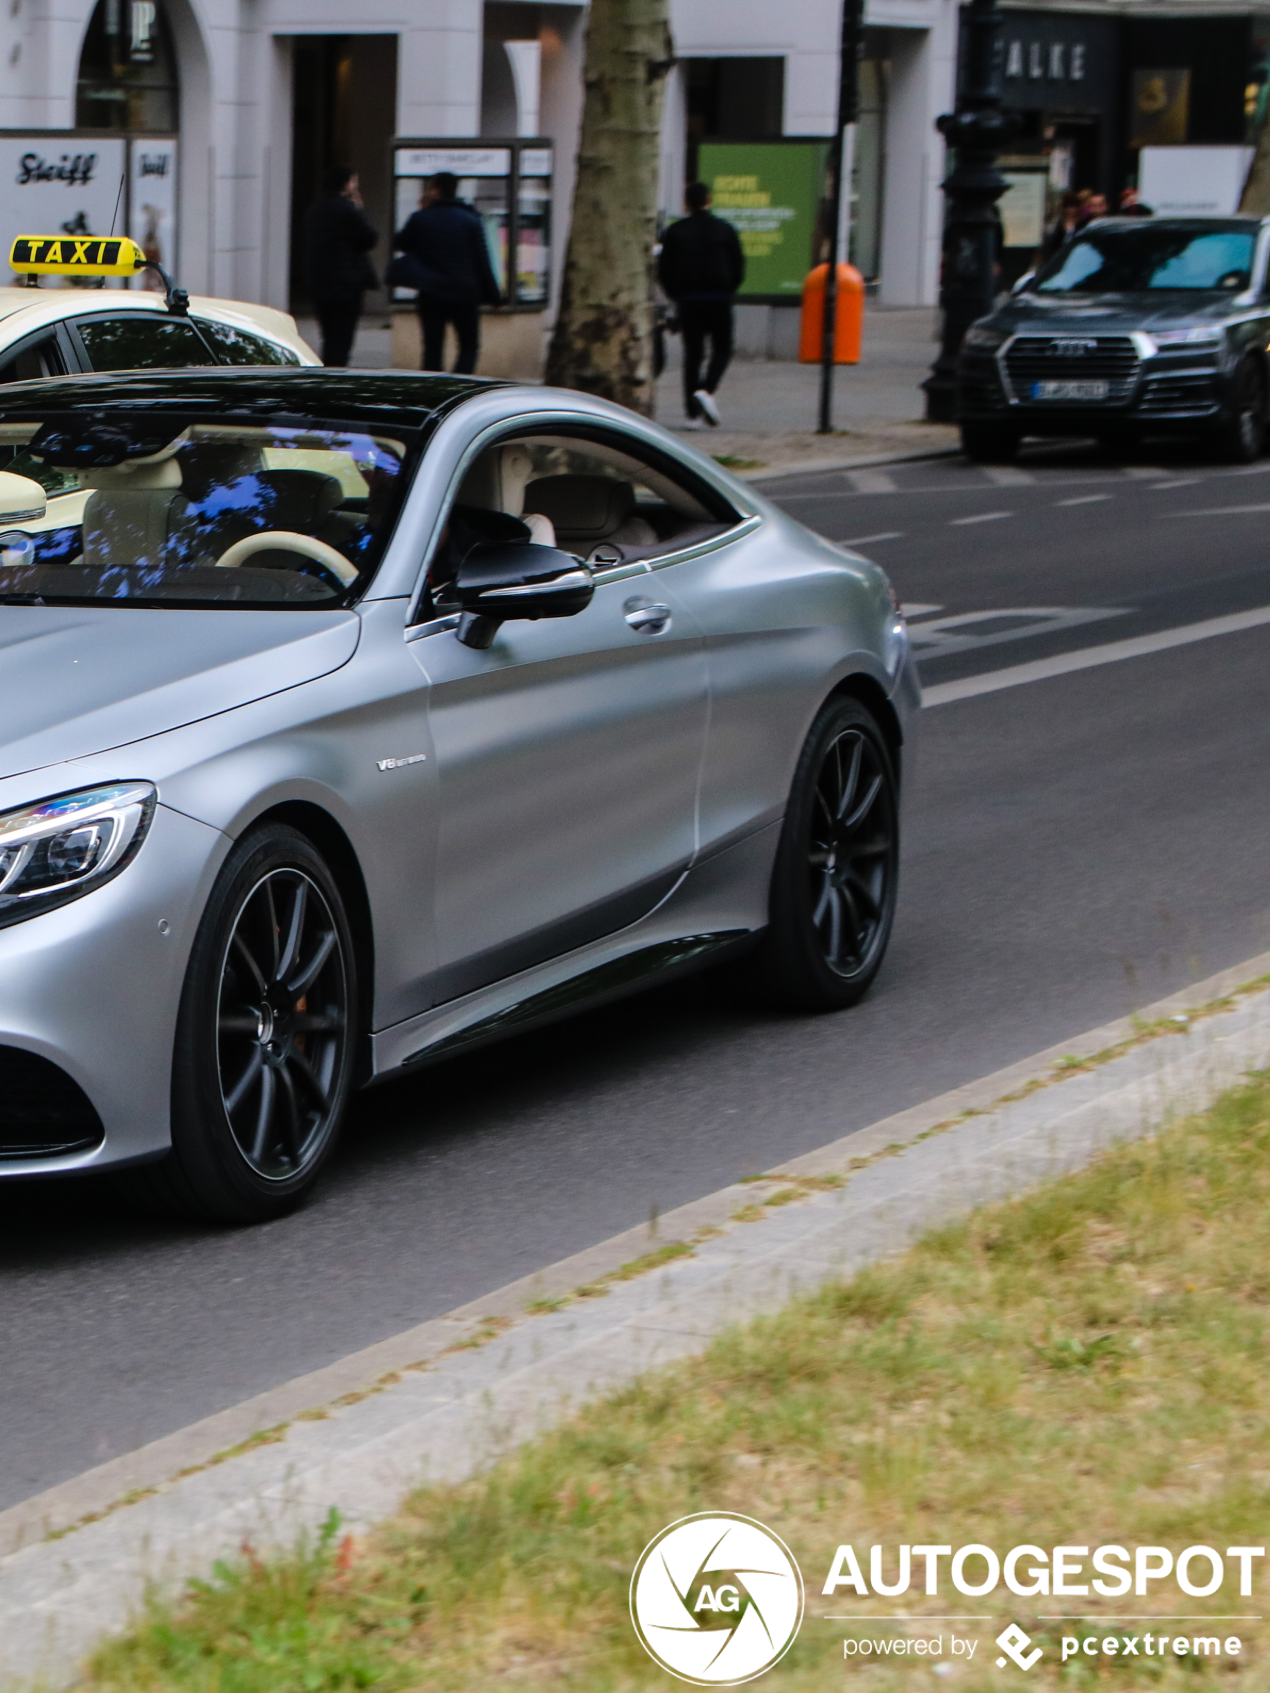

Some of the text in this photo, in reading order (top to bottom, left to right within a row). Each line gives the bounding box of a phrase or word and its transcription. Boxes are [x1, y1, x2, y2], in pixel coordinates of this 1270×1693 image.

[16, 153, 96, 187] Steiff
[27, 240, 107, 264] TAXI
[376, 758, 396, 772] V8
